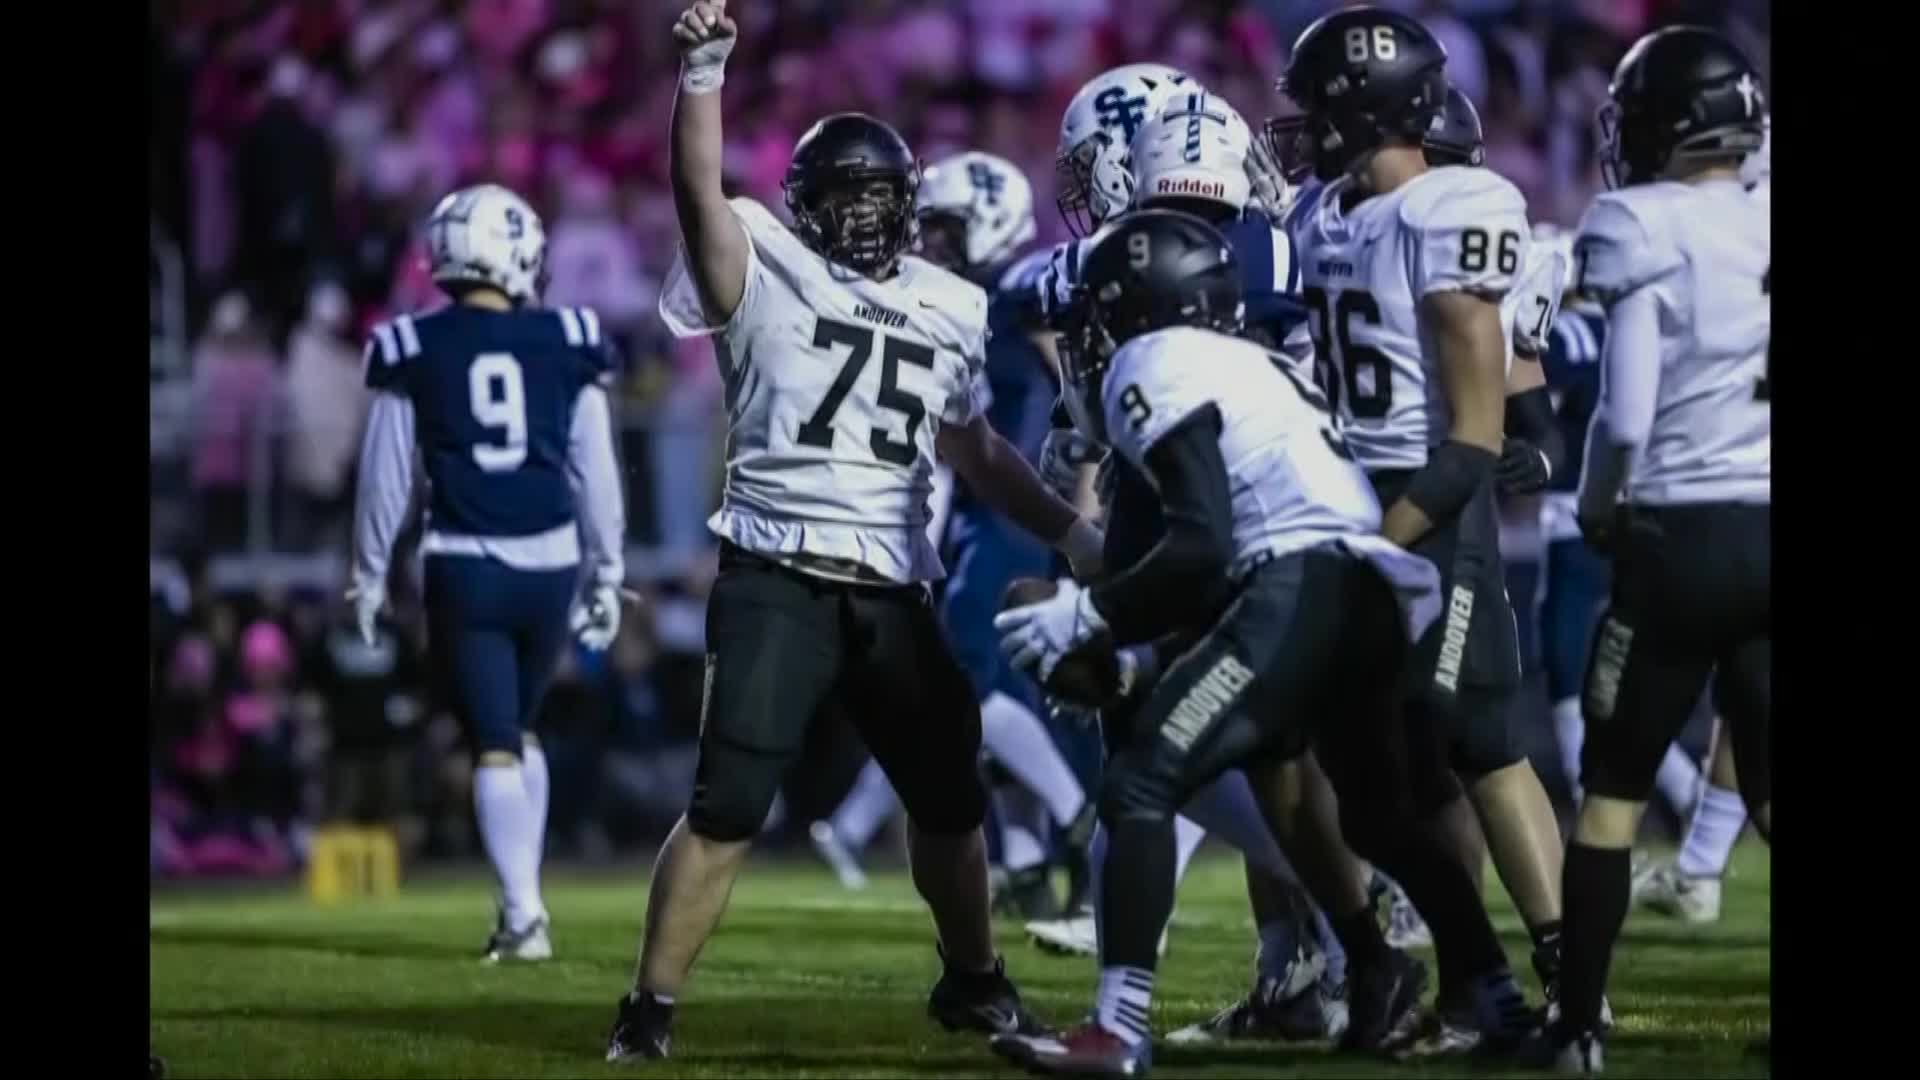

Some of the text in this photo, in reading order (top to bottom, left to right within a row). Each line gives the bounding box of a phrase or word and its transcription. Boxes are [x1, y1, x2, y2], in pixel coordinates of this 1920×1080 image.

[1345, 24, 1396, 62] 86
[1158, 178, 1225, 198] Riddell
[504, 207, 524, 239] 9
[1128, 232, 1150, 270] 9
[1460, 227, 1520, 275] 86
[853, 303, 909, 328] ANDOVER
[469, 351, 528, 473] 9
[797, 315, 936, 468] 75
[1120, 382, 1152, 428] 9
[1434, 584, 1475, 693] ANDOVER
[1160, 655, 1256, 753] ANDOVER
